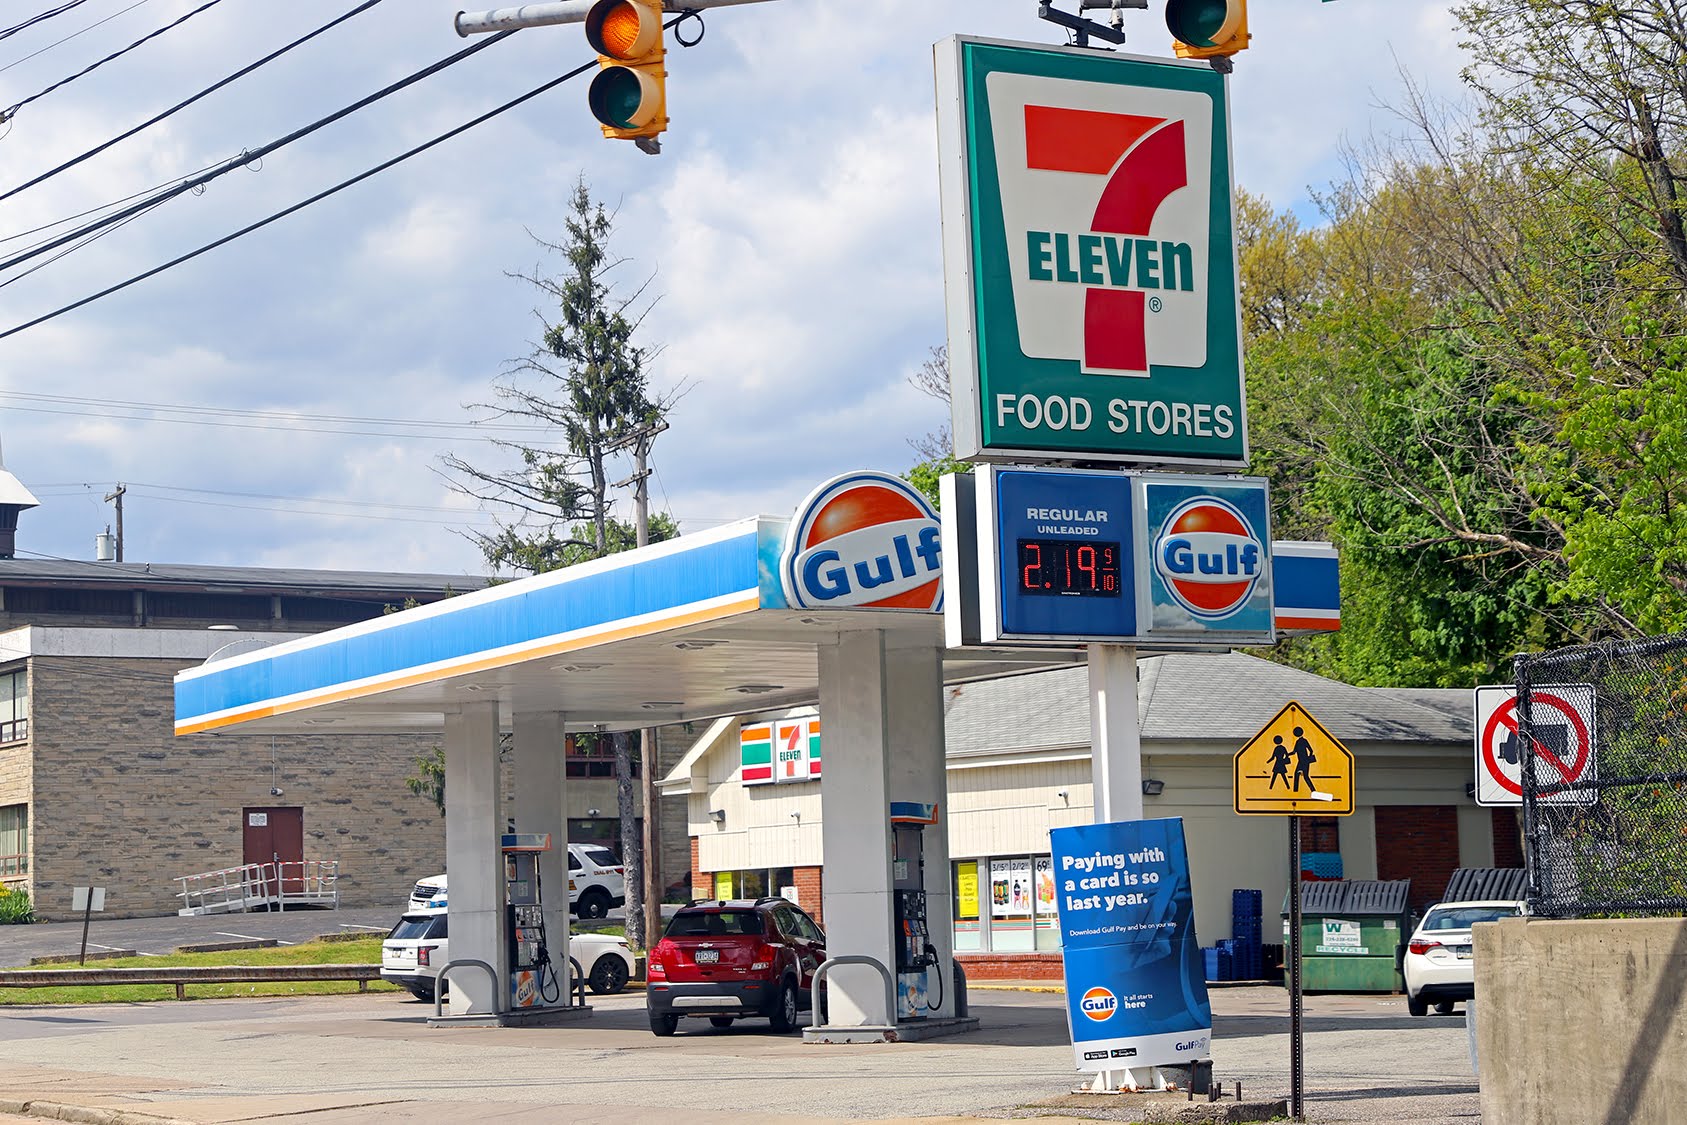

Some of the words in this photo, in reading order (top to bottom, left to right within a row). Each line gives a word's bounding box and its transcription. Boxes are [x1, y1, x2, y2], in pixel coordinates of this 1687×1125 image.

[1023, 103, 1188, 372] 7
[996, 393, 1093, 431] FOOD
[1107, 398, 1235, 439] STORES
[1026, 507, 1109, 523] REGULAR
[1037, 525, 1099, 536] UNLEADED
[803, 526, 942, 601] Gulf
[1163, 537, 1259, 575] Gulf
[1024, 544, 1097, 590] 2.19
[780, 725, 799, 776] 7
[1062, 852, 1125, 872] Paying
[1129, 848, 1164, 863] with
[1065, 880, 1075, 891] a
[1080, 872, 1119, 889] card
[1124, 870, 1138, 885] is
[1142, 873, 1159, 884] so
[1066, 895, 1102, 911] last
[1104, 893, 1148, 911] year.
[1070, 928, 1100, 936] Download
[1101, 926, 1115, 934] Gulf
[1115, 925, 1126, 933] Pay
[1127, 923, 1139, 931] and
[1156, 922, 1167, 931] your
[518, 980, 534, 1000] Gulf
[1082, 997, 1116, 1010] Gulf
[1124, 1000, 1146, 1009] here
